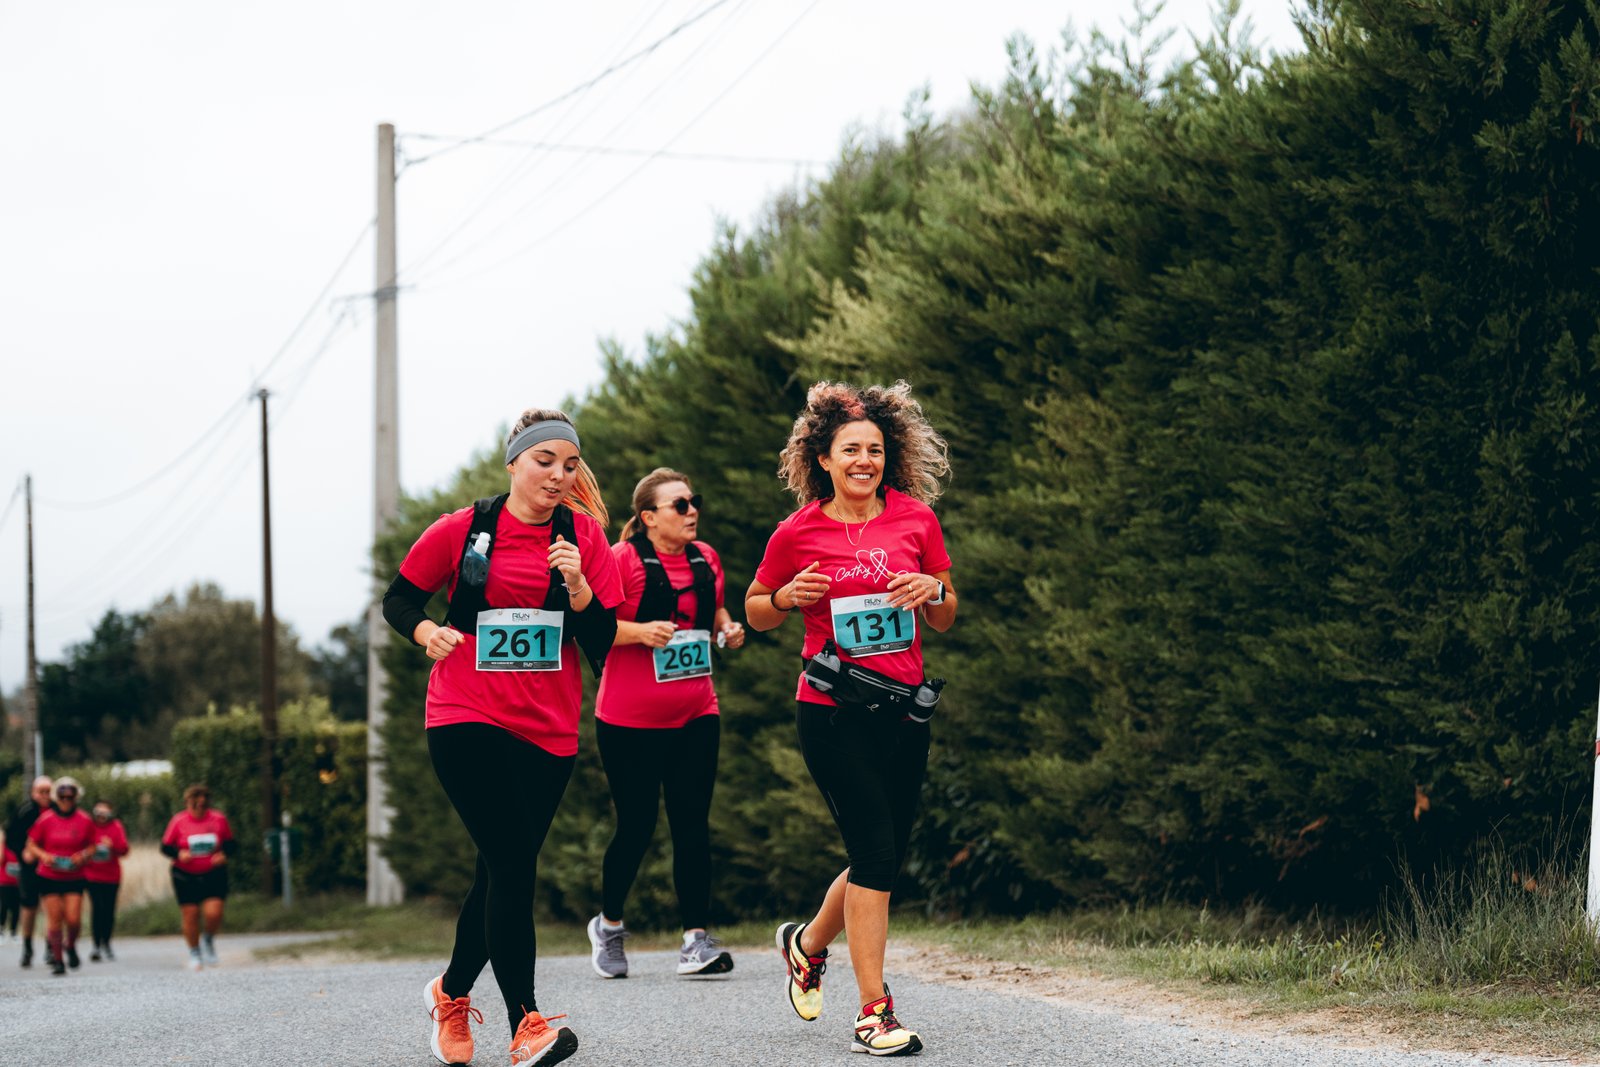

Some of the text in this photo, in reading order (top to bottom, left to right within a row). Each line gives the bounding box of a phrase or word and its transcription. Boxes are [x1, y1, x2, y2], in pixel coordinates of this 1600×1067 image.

[835, 565, 871, 582] Cathy
[845, 610, 902, 643] 131
[488, 628, 546, 658] 261
[662, 643, 705, 671] 262
